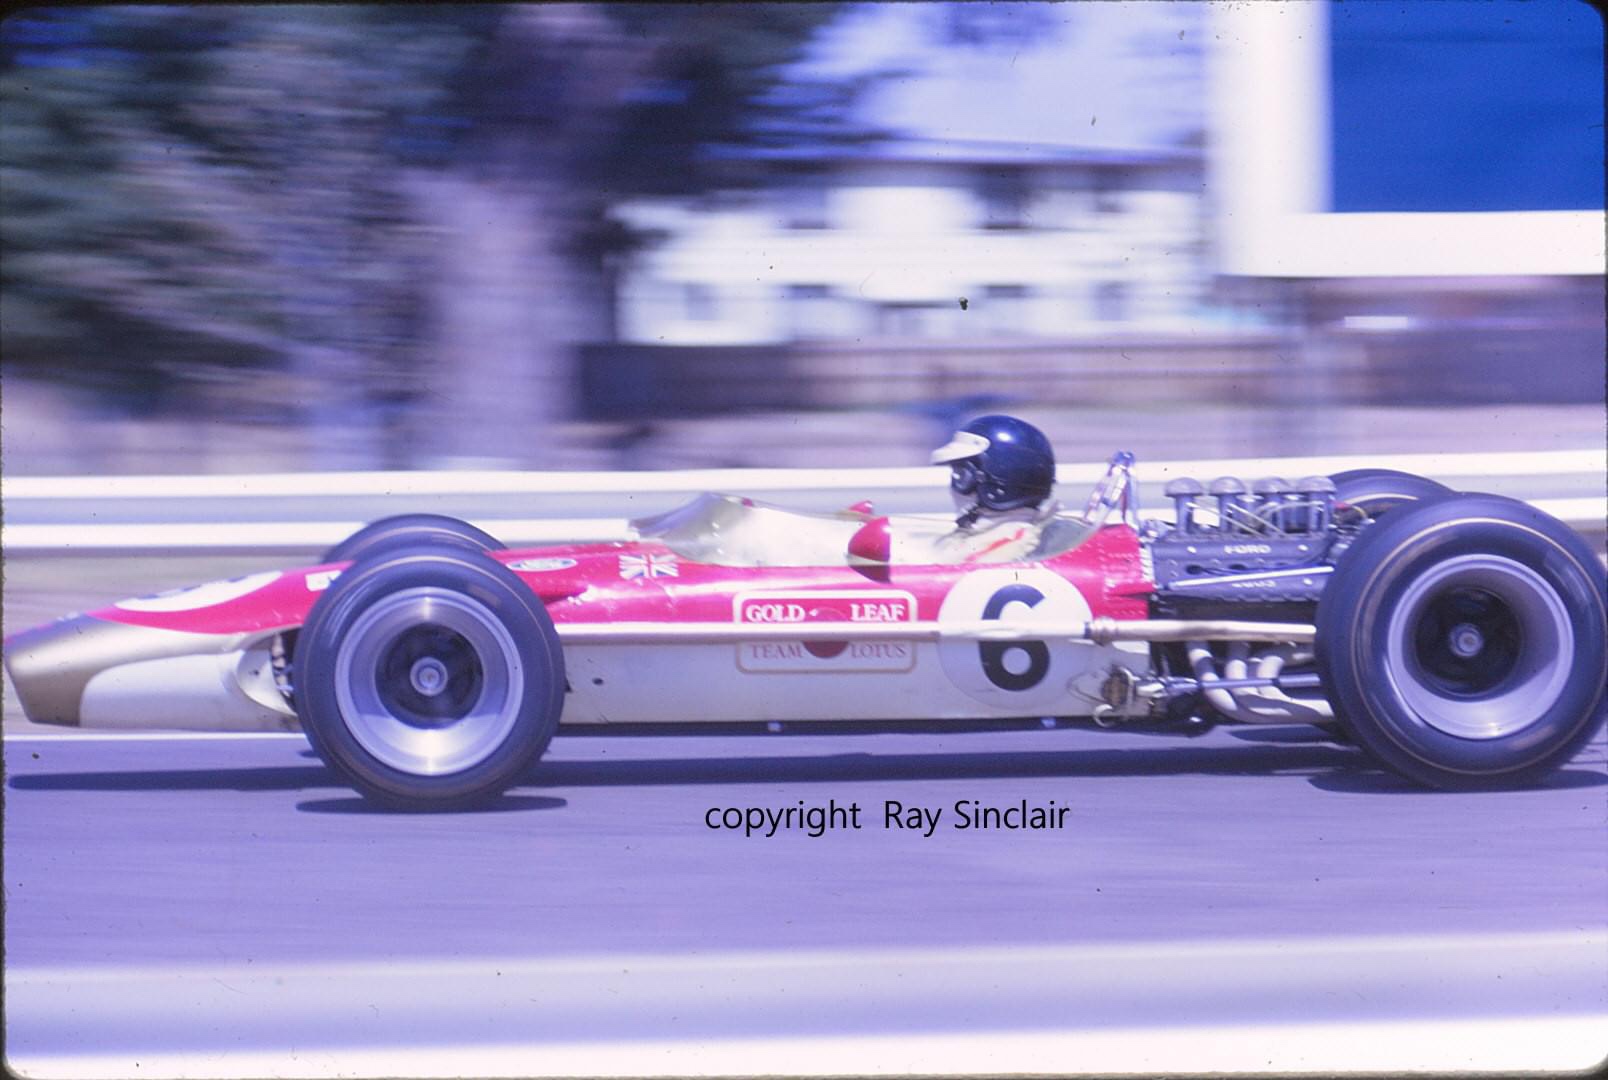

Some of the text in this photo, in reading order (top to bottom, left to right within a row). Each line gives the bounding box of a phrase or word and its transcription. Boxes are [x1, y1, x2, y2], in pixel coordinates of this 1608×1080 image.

[1223, 544, 1272, 554] FORD
[745, 603, 905, 622] GOLD LEAF
[978, 584, 1051, 692] 6
[751, 643, 906, 659] TEAM LOTUS
